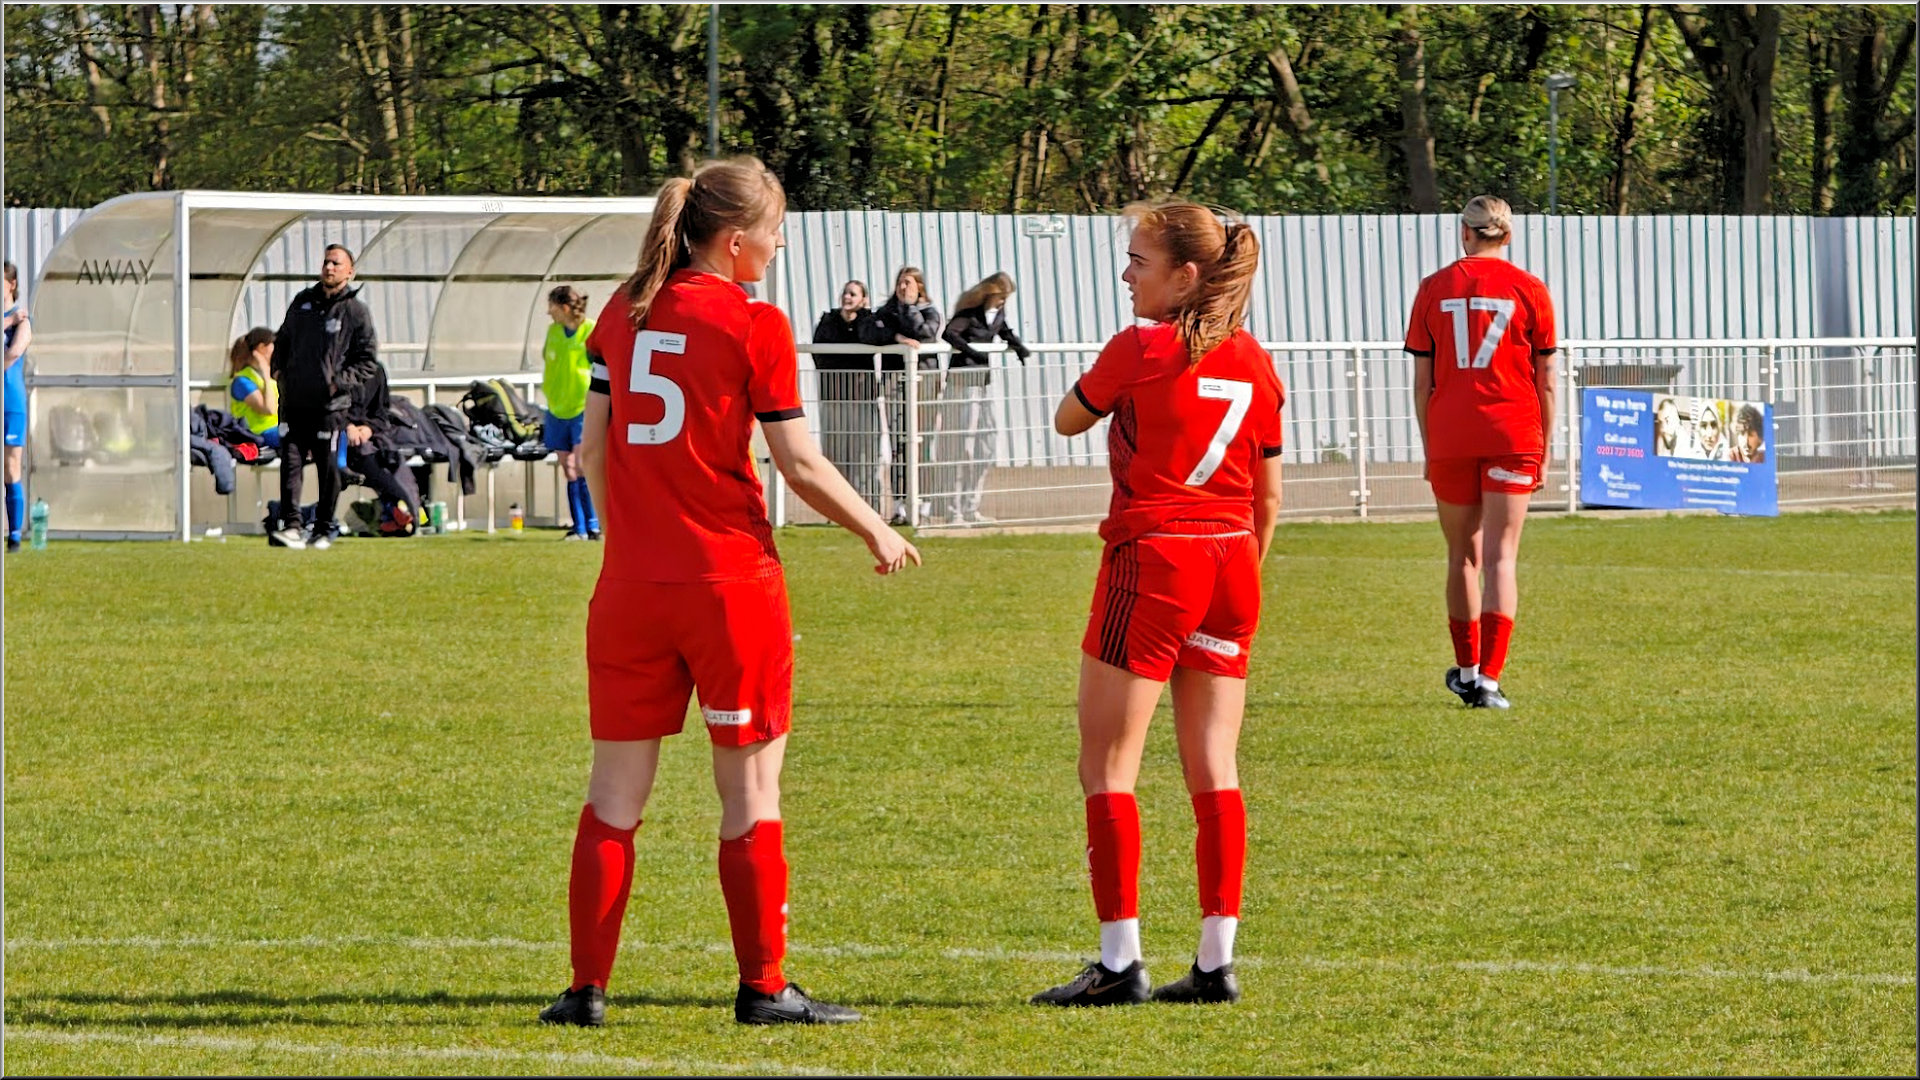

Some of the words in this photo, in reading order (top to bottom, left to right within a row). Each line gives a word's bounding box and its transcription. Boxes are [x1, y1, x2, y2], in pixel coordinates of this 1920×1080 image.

[76, 259, 154, 285] AWAY
[1440, 298, 1515, 369] 17
[627, 329, 687, 445] 5
[1595, 395, 1610, 408] We
[1612, 400, 1625, 410] are
[1627, 398, 1647, 412] here
[1603, 411, 1617, 423] for
[1618, 411, 1639, 427] you!
[1184, 377, 1253, 486] 7
[1604, 433, 1618, 443] Call
[1189, 633, 1235, 654] UATTRO
